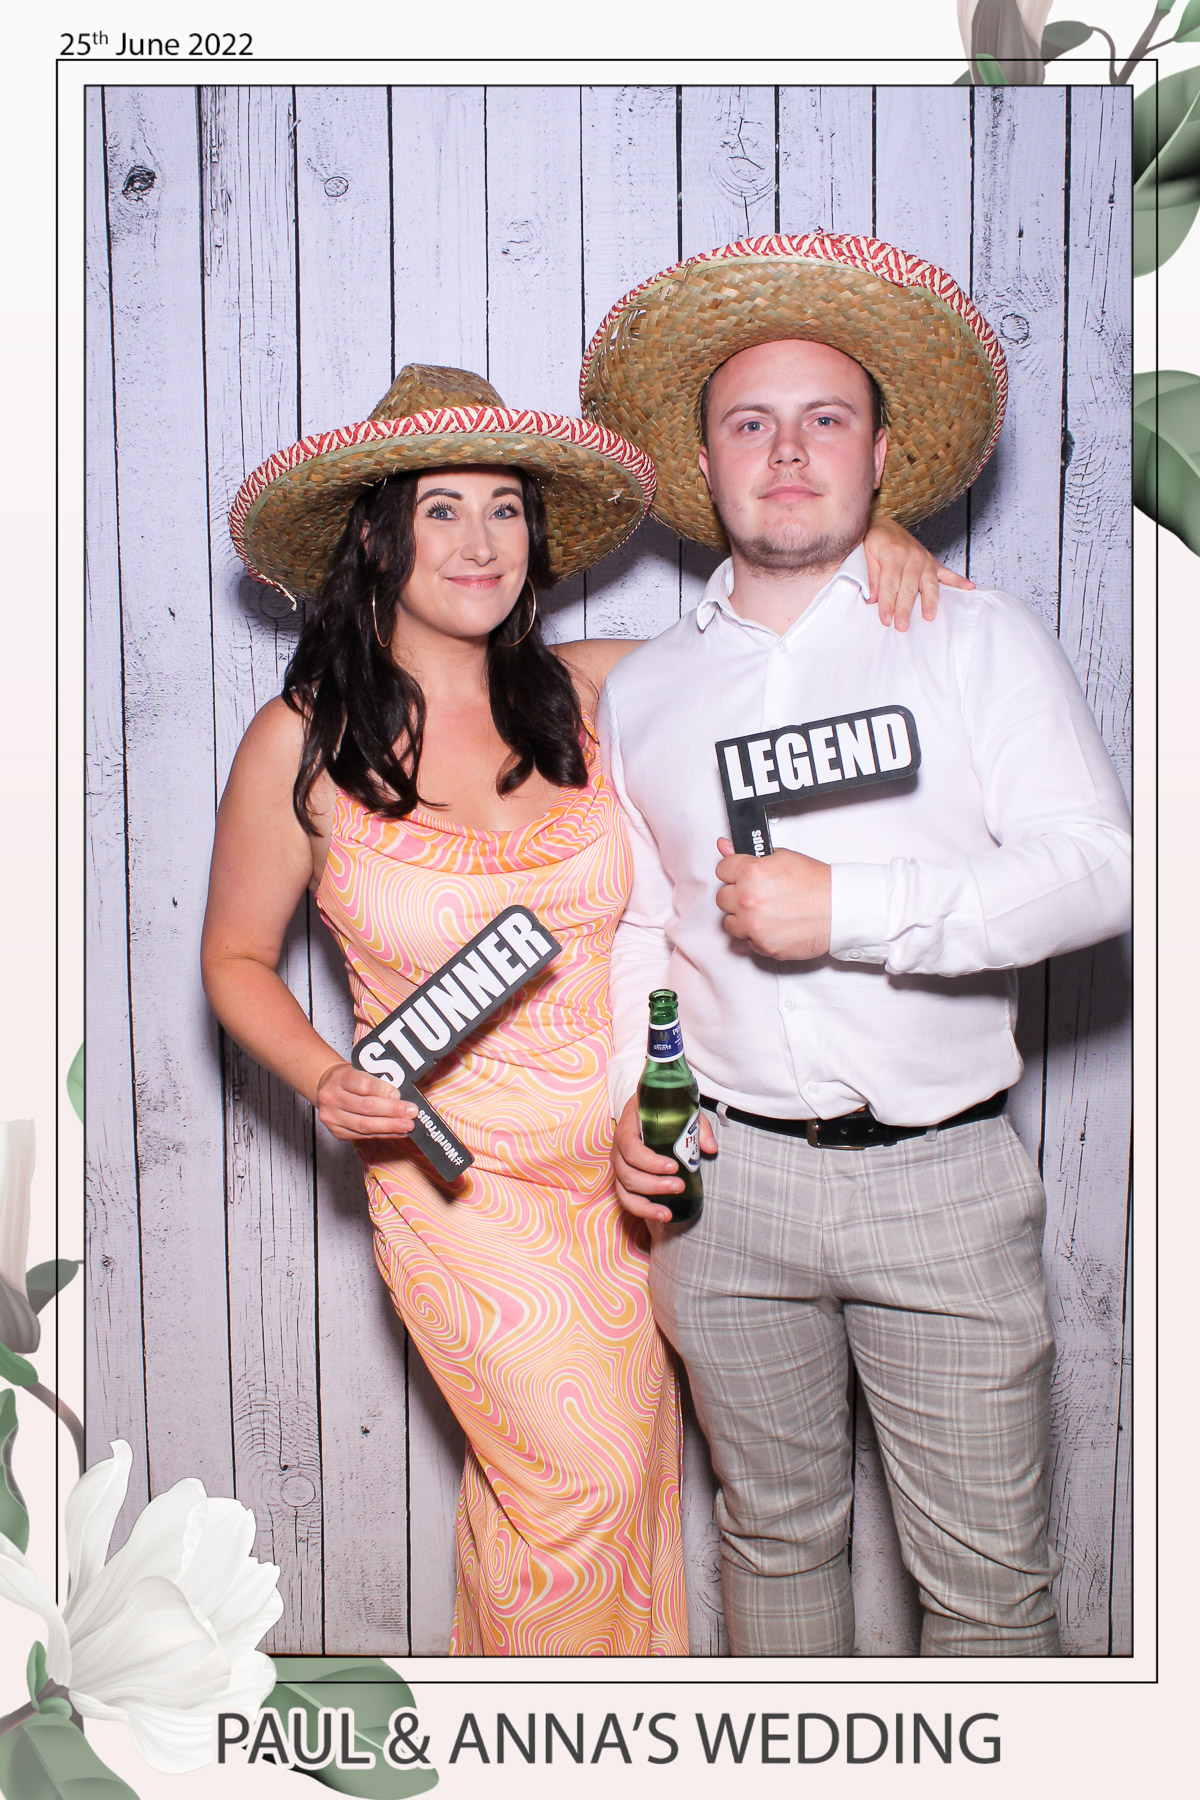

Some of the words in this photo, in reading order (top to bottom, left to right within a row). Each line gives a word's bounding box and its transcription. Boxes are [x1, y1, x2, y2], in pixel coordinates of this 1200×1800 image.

[723, 712, 913, 801] LEGEND
[751, 829, 766, 858] rops
[358, 912, 553, 1090] STUNNER
[417, 1109, 465, 1167] #WordProps
